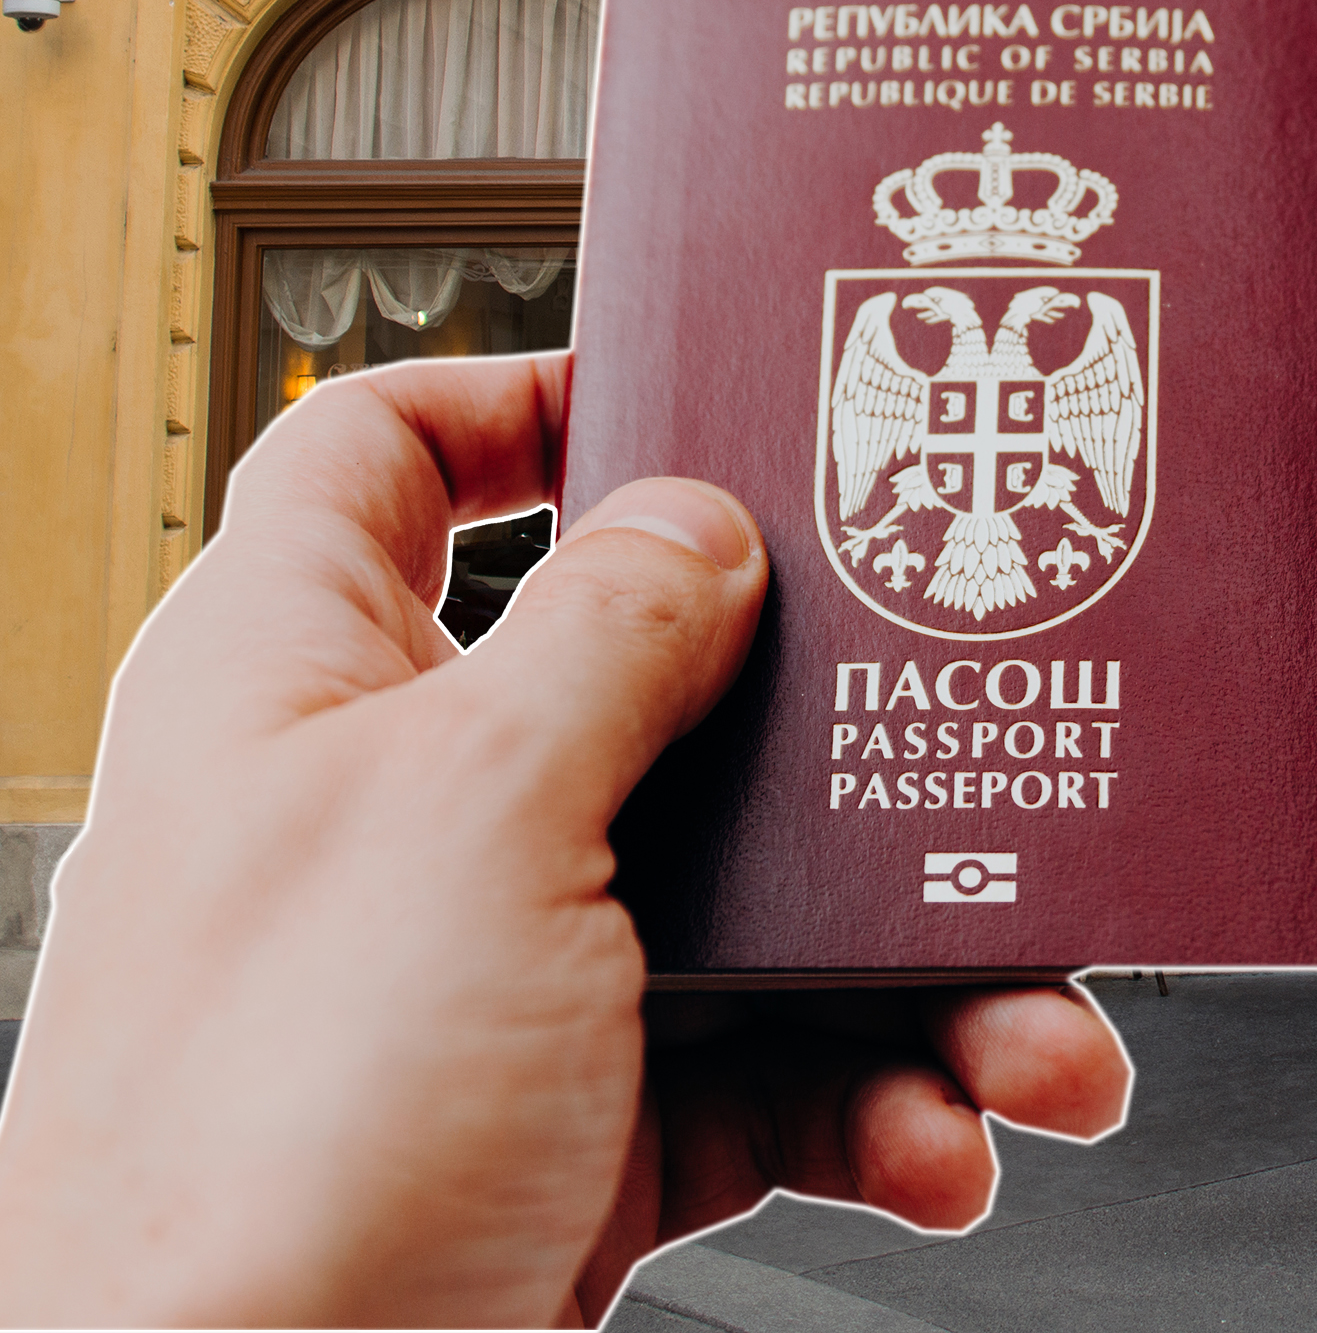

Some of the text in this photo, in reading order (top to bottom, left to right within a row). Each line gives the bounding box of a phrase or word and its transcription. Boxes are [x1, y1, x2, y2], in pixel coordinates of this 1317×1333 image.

[787, 3, 1215, 43] РЕПУБЛИКА СРБИЈА
[785, 43, 1215, 76] REPUBLIC OF SERBIA
[784, 79, 1215, 112] REPUBLIQUE DE SERBIE
[834, 659, 1121, 711] ПАСОШ
[830, 720, 1121, 760] PASSPORT
[829, 770, 1119, 810] PASSEPORT
